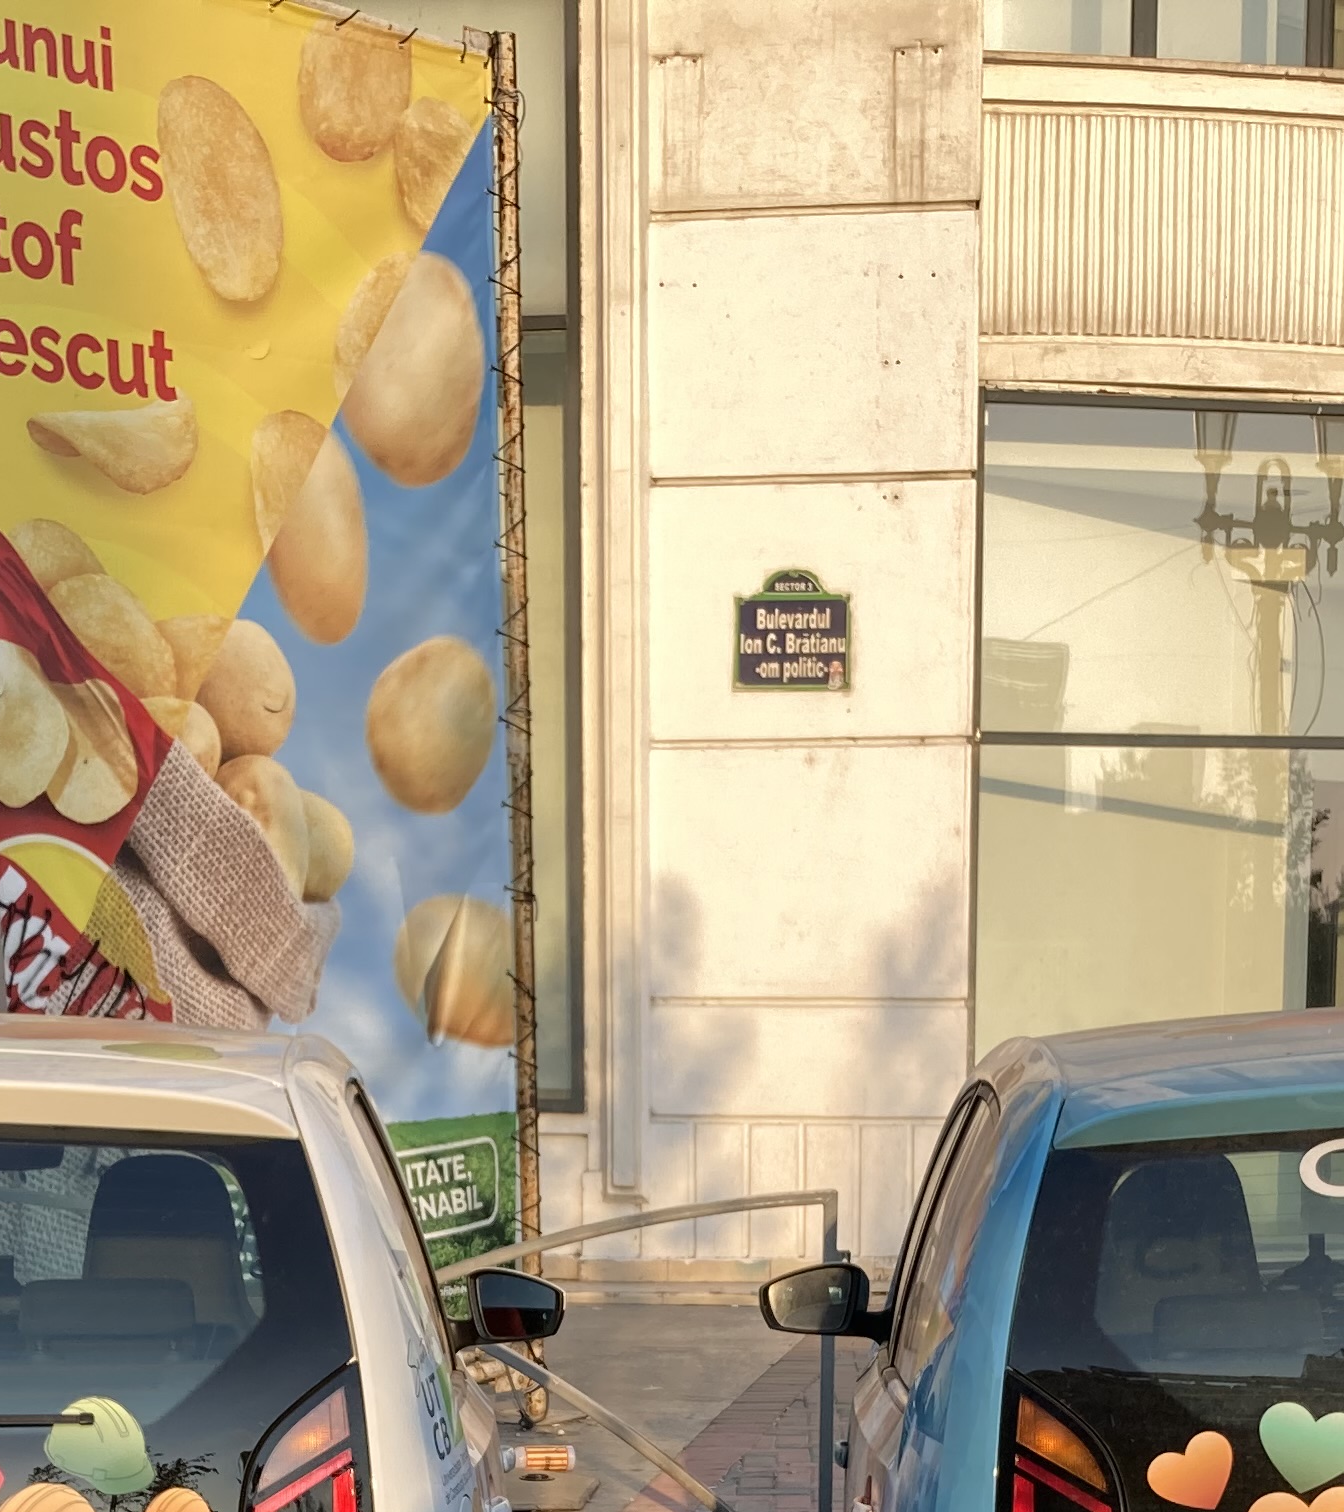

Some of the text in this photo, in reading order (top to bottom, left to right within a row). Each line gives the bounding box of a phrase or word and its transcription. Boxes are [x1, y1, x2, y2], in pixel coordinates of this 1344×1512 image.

[775, 582, 806, 592] SECTOR
[756, 607, 831, 630] Bulevardul
[740, 632, 846, 654] Ion C. Brătianu
